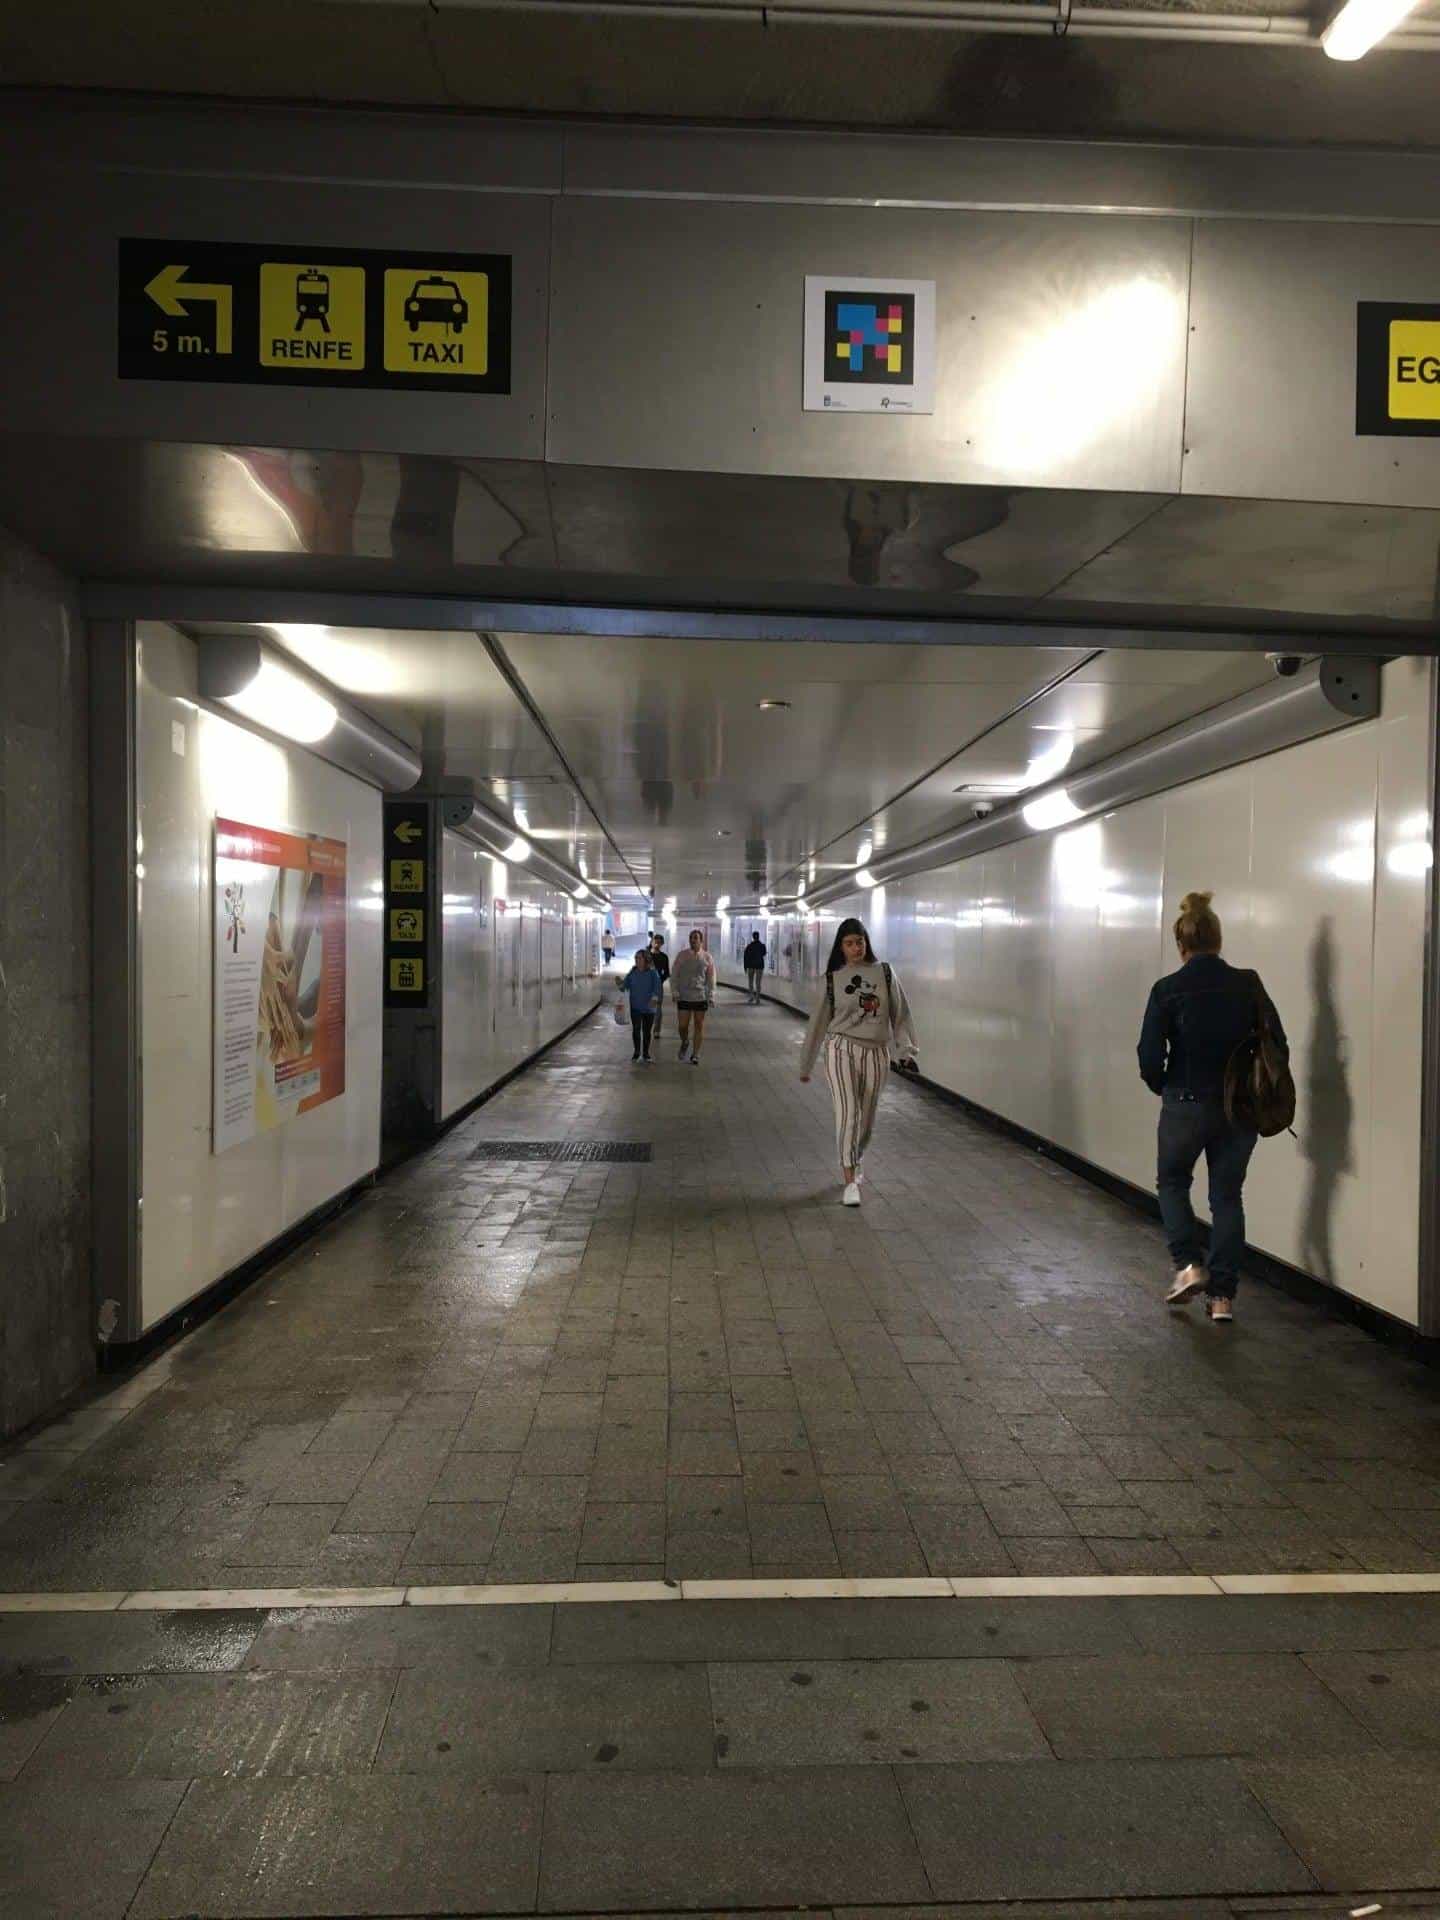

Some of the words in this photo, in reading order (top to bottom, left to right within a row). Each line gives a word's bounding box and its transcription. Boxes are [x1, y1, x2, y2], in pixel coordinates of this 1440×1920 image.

[153, 330, 168, 352] 5
[178, 335, 210, 353] m.
[272, 339, 352, 361] RENFE
[408, 342, 464, 363] TAXI
